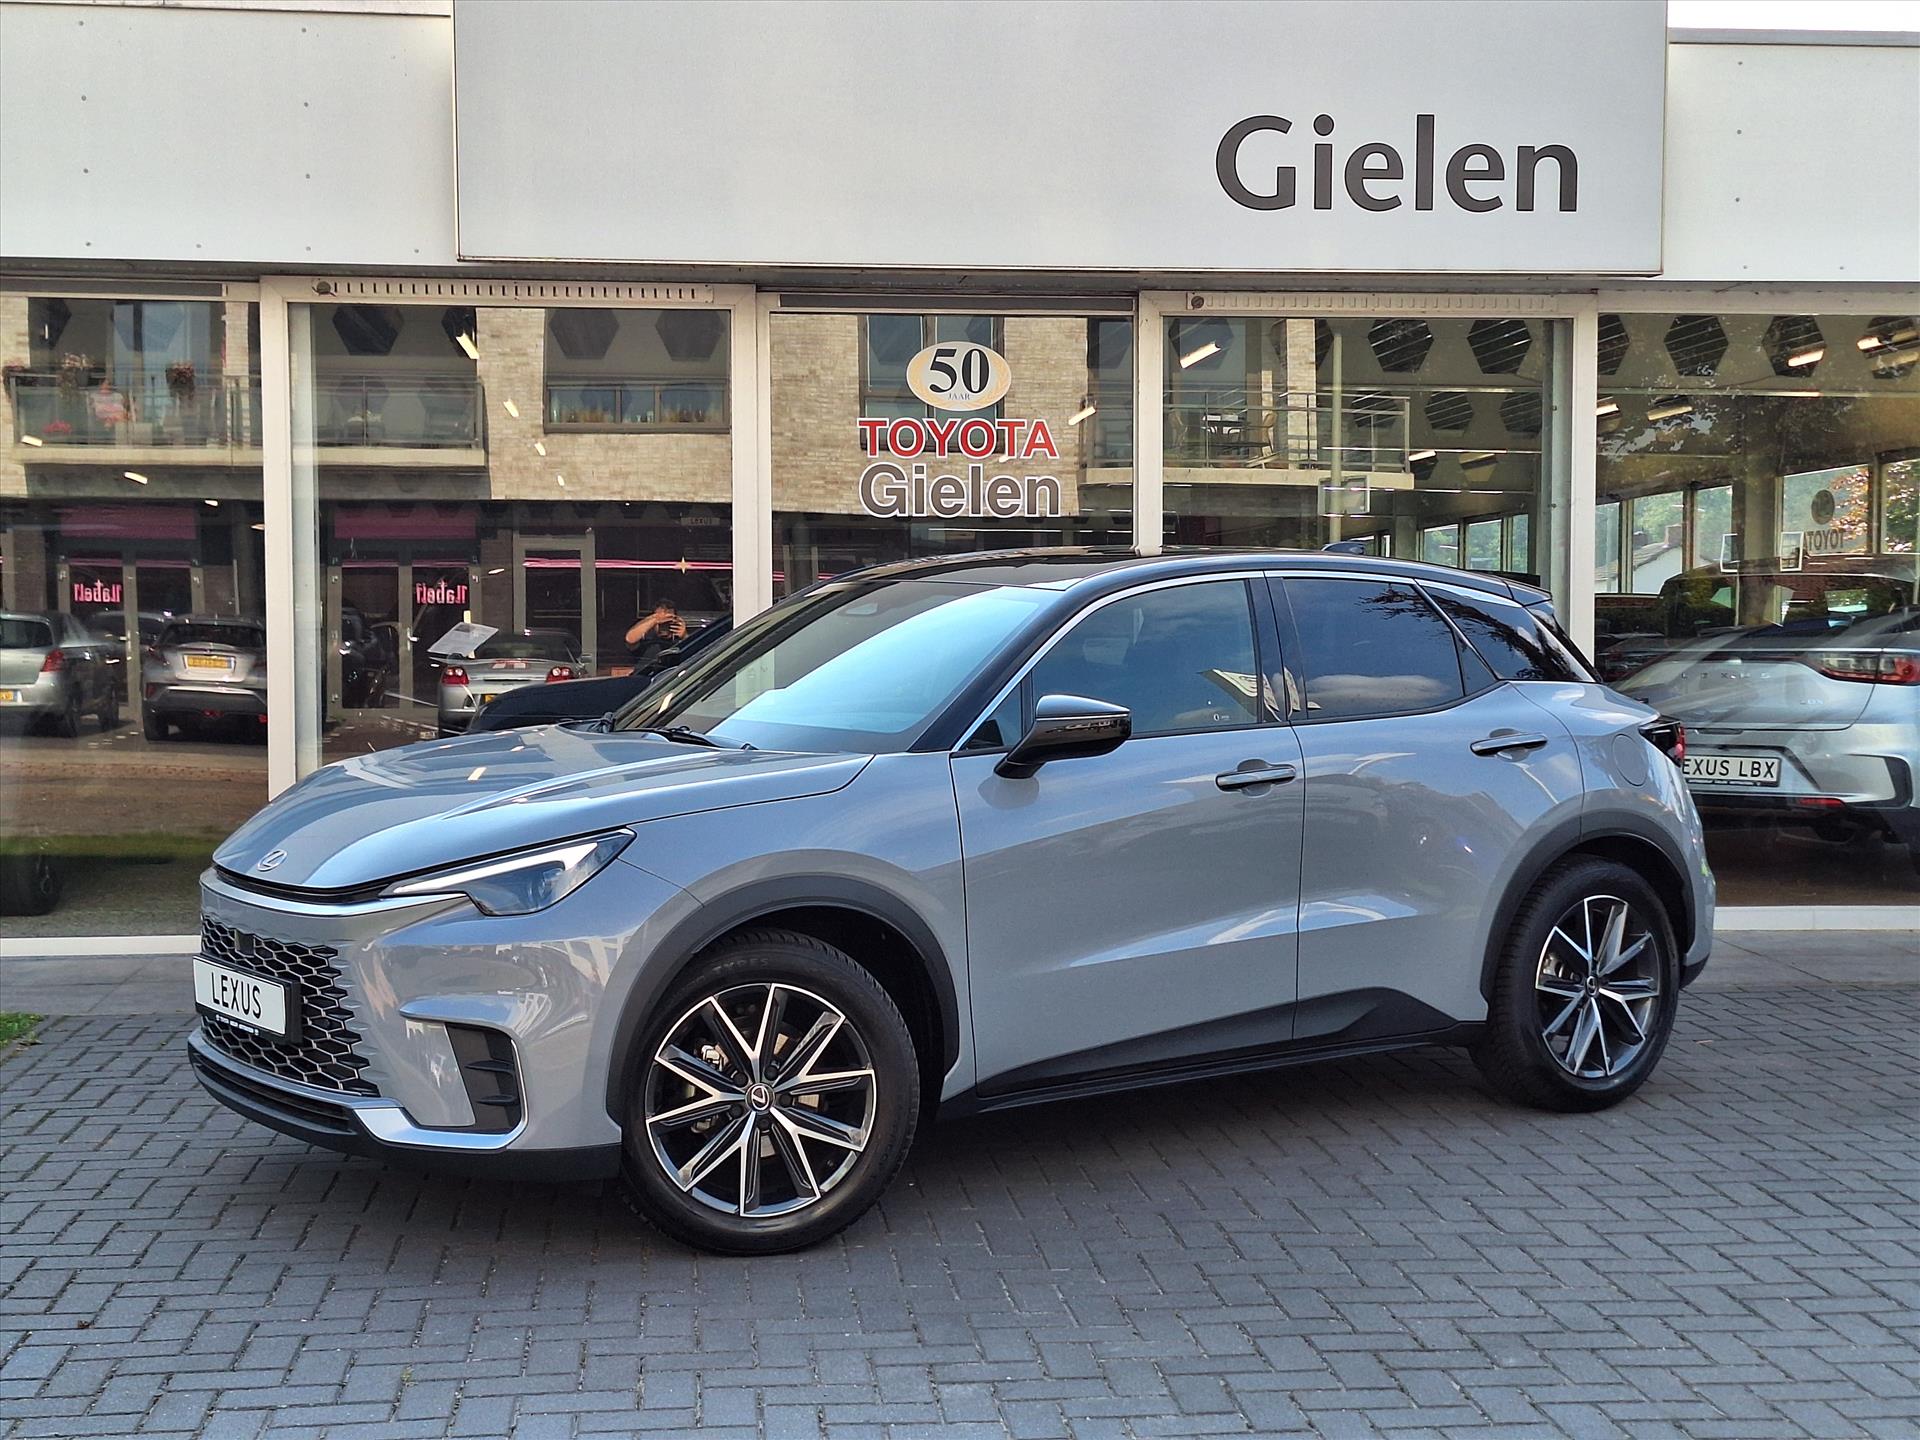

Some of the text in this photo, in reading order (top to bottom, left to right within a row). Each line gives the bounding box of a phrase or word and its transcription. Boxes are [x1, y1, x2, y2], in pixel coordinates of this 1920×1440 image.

[1215, 113, 1579, 213] Gielen
[928, 348, 990, 393] 50
[857, 418, 1060, 459] TOYOTA
[859, 462, 1061, 518] Gielen
[1682, 758, 1776, 778] EXUS LBX
[211, 971, 261, 1020] LEXUS
